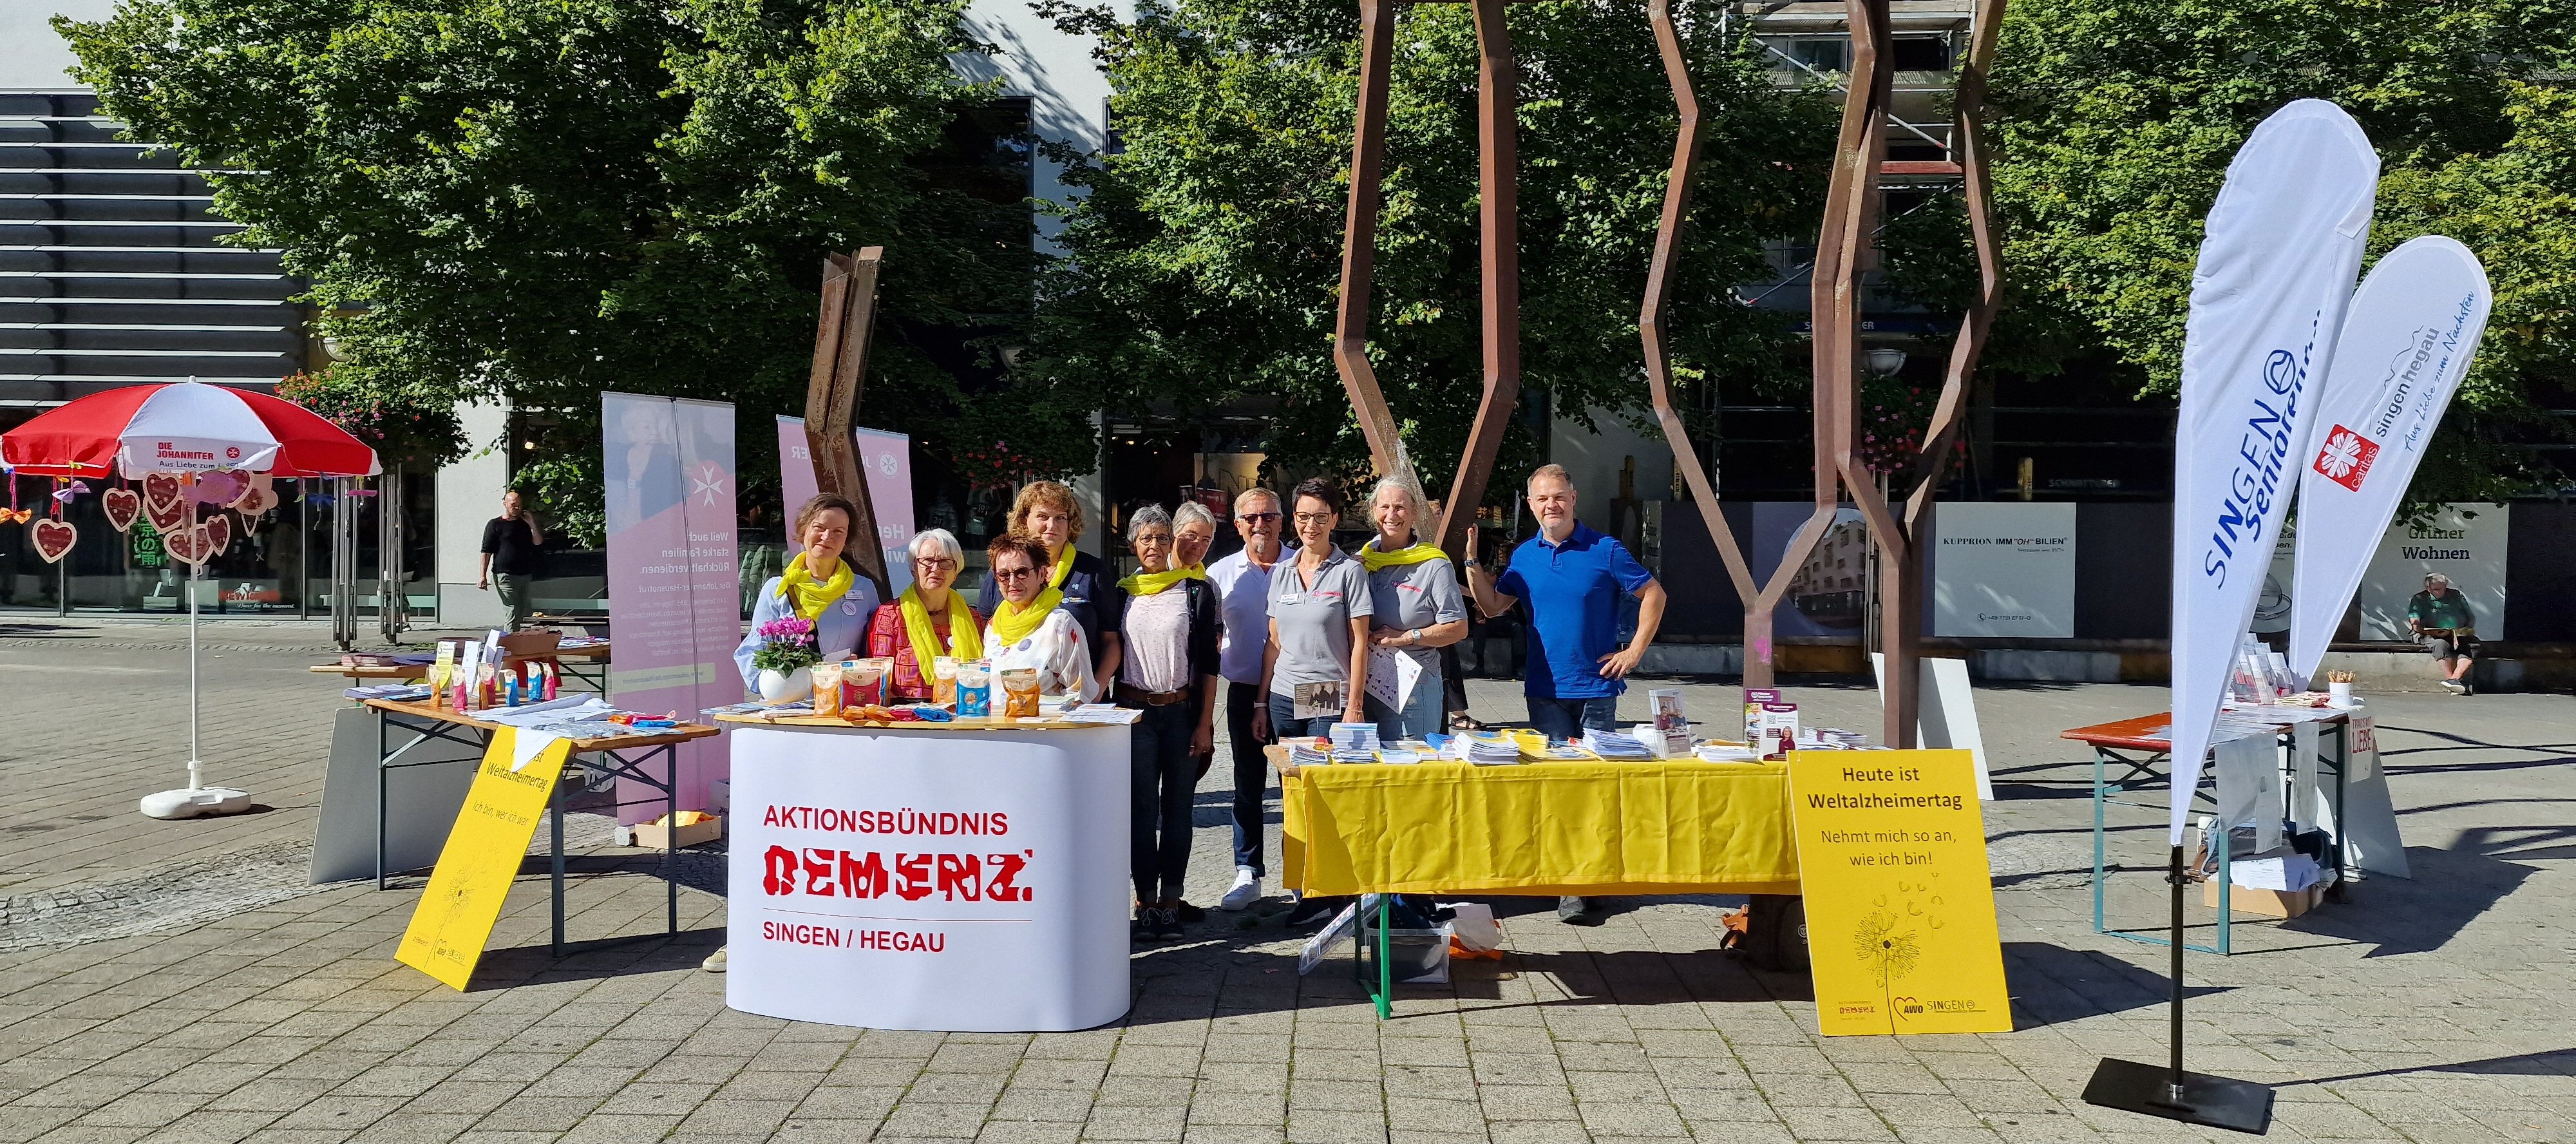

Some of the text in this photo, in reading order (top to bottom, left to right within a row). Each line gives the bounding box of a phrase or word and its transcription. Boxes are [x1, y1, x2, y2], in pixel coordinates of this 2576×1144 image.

[2405, 291, 2475, 452] Aus Liebe zum Nächsten
[156, 450, 214, 461] JOHANNITER
[2351, 446, 2378, 489] caritas
[2205, 399, 2280, 591] SINGEN
[2401, 546, 2470, 560] Wohnen
[2352, 728, 2371, 754] LIEBE
[1842, 767, 1920, 782] Heute ist
[472, 800, 483, 812] Ich
[495, 809, 506, 820] wer
[507, 810, 517, 823] ich
[516, 816, 529, 826] war
[1807, 793, 1963, 811] Weltalzheimertag
[763, 805, 1009, 836] AKTIONSBÜNDNIS
[1821, 829, 1957, 844] Nehmt mich so an,
[1849, 851, 1933, 866] wie ich bin!
[763, 844, 1033, 902] DEMENZ
[763, 921, 945, 953] SINGEN / HEGAU
[1904, 1005, 1924, 1015] AWO
[1926, 1000, 1964, 1011] SINGEN
